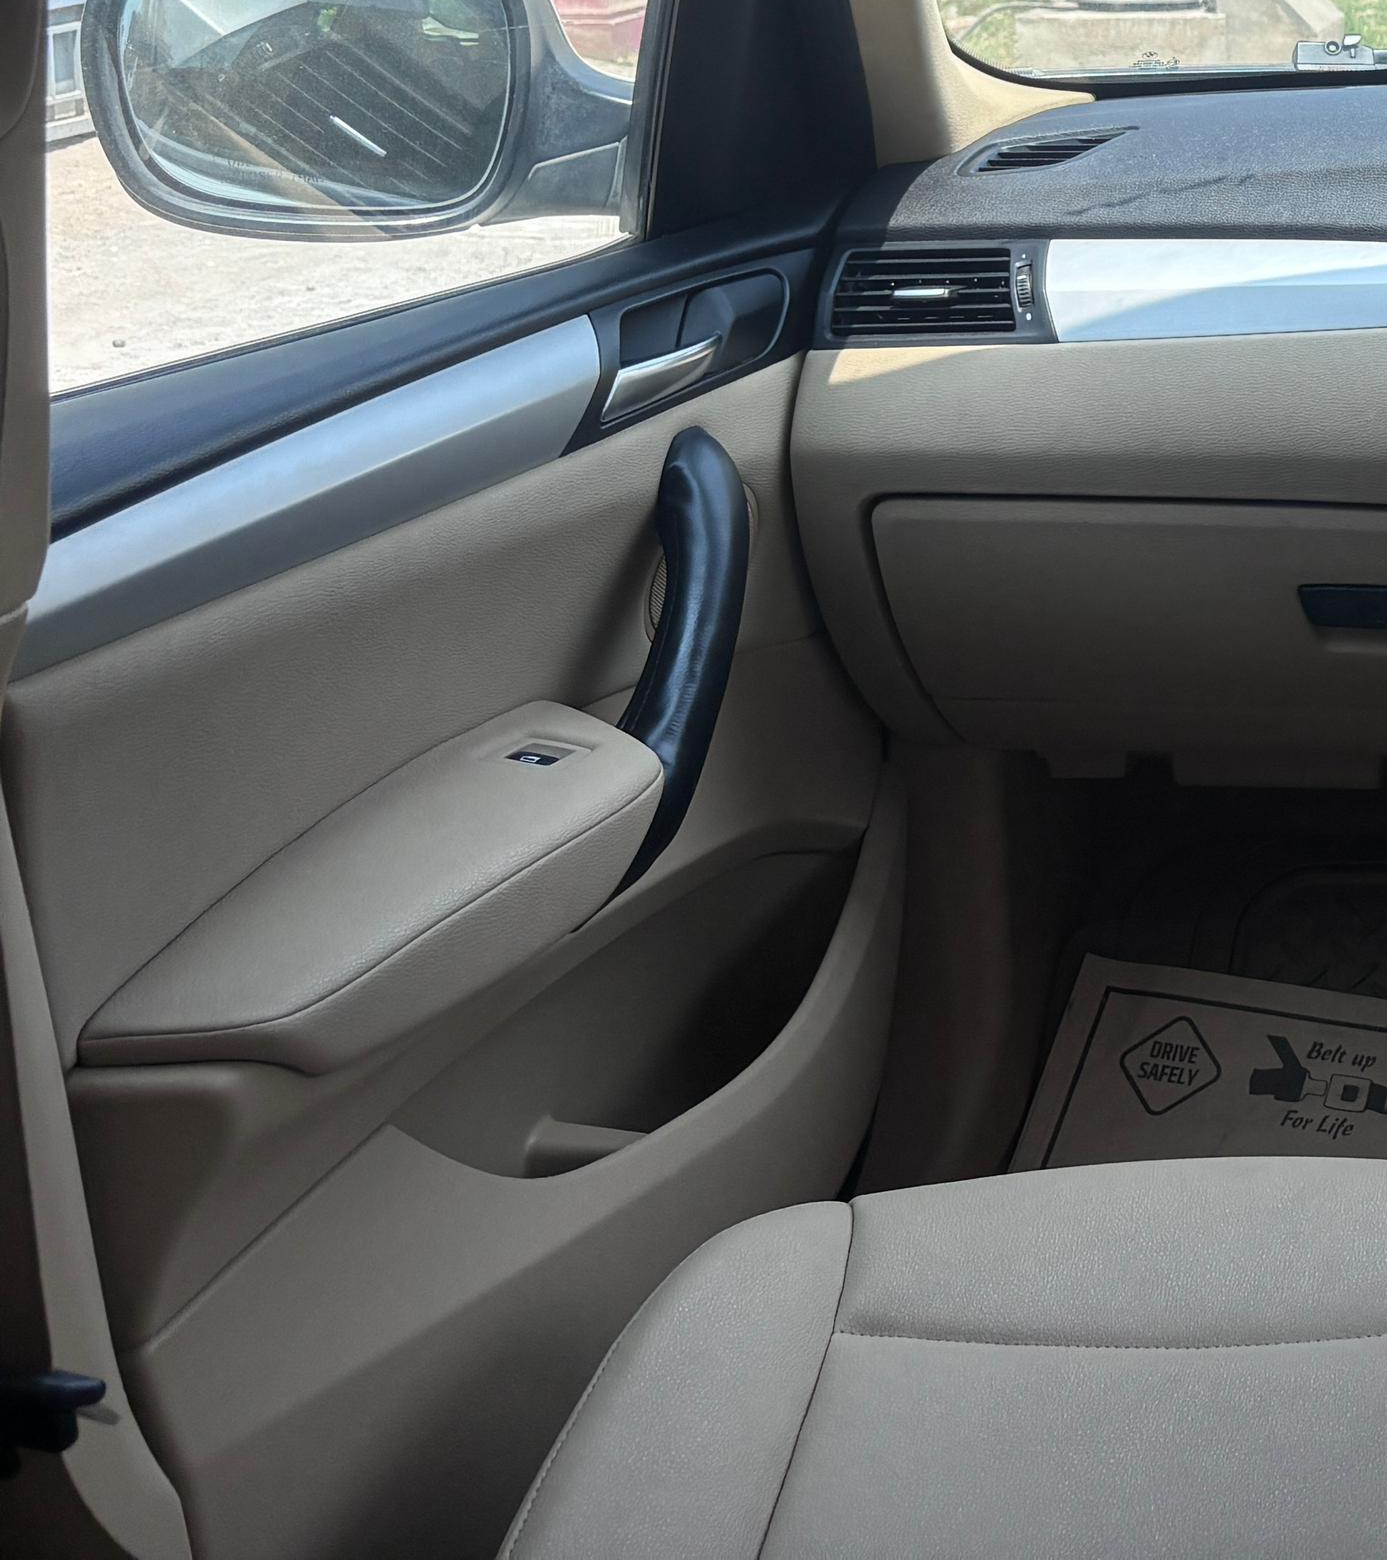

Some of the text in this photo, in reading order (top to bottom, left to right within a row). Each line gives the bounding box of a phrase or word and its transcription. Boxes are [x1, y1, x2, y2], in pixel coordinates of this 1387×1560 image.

[1150, 1040, 1200, 1064] DRIVE
[1306, 1041, 1377, 1072] Belt up
[1137, 1061, 1200, 1086] SAFELY
[1280, 1110, 1354, 1140] For Life
